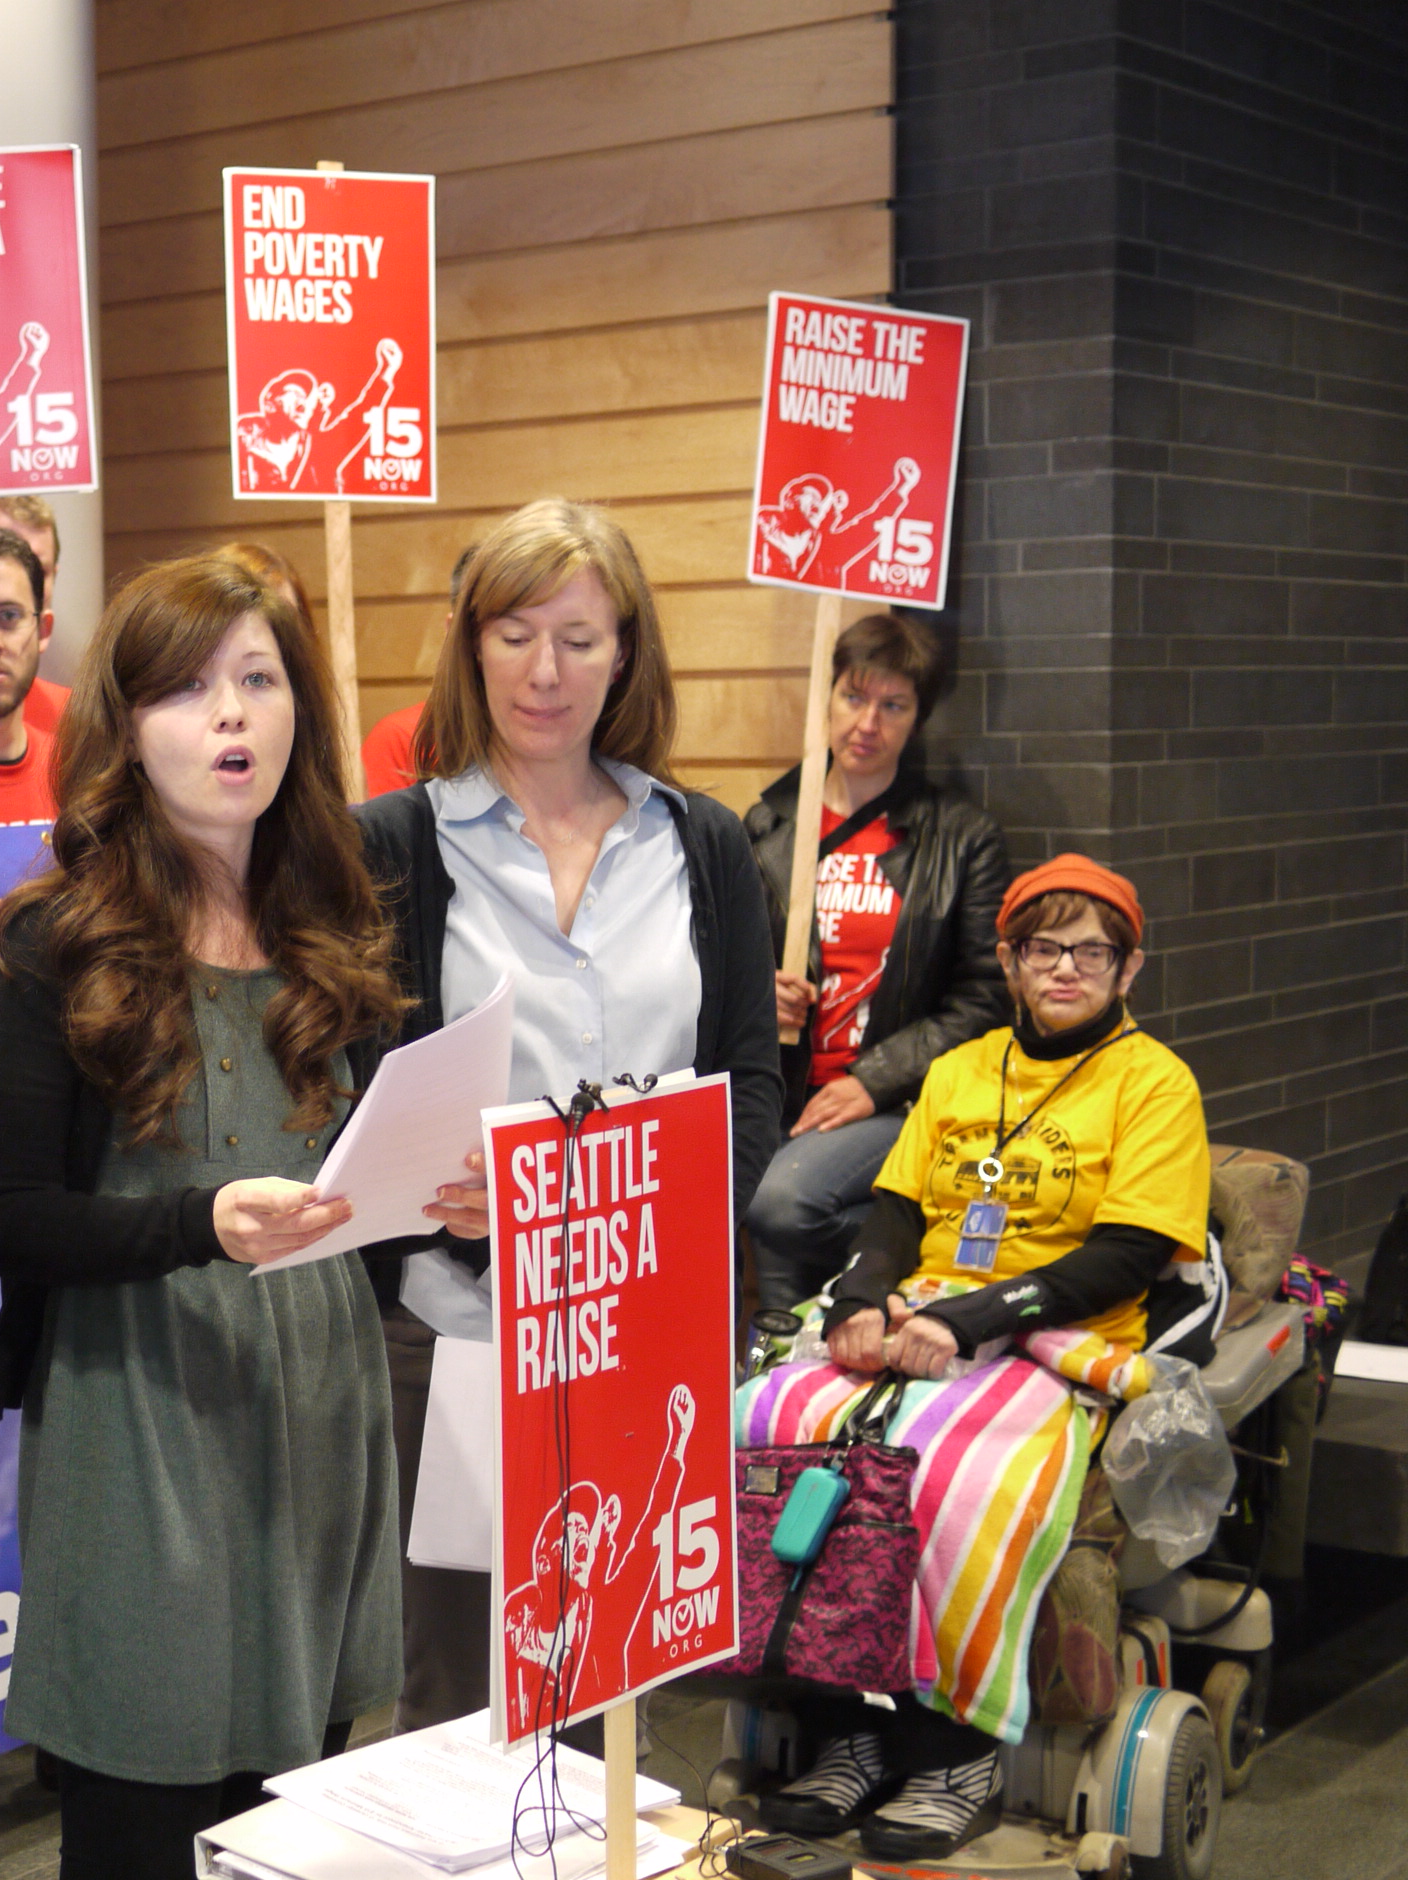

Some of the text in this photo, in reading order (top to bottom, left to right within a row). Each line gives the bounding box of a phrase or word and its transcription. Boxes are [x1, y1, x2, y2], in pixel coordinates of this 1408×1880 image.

[243, 185, 305, 230] END
[244, 232, 383, 278] POVERTY
[244, 278, 352, 323] WAGES
[785, 308, 925, 363] RAISE THE
[781, 346, 908, 400] MINIMUM
[7, 392, 78, 447] 15
[362, 406, 423, 458] 15
[779, 384, 855, 432] WAGE
[10, 446, 78, 472] NOW
[364, 457, 422, 482] NOW
[873, 516, 934, 567] 15
[869, 560, 930, 589] NOW
[512, 1120, 659, 1222] SEATTLE
[516, 1203, 657, 1308] NEEDS A
[517, 1295, 619, 1394] RAISE
[652, 1496, 720, 1602] 15
[653, 1585, 720, 1648] NOW
